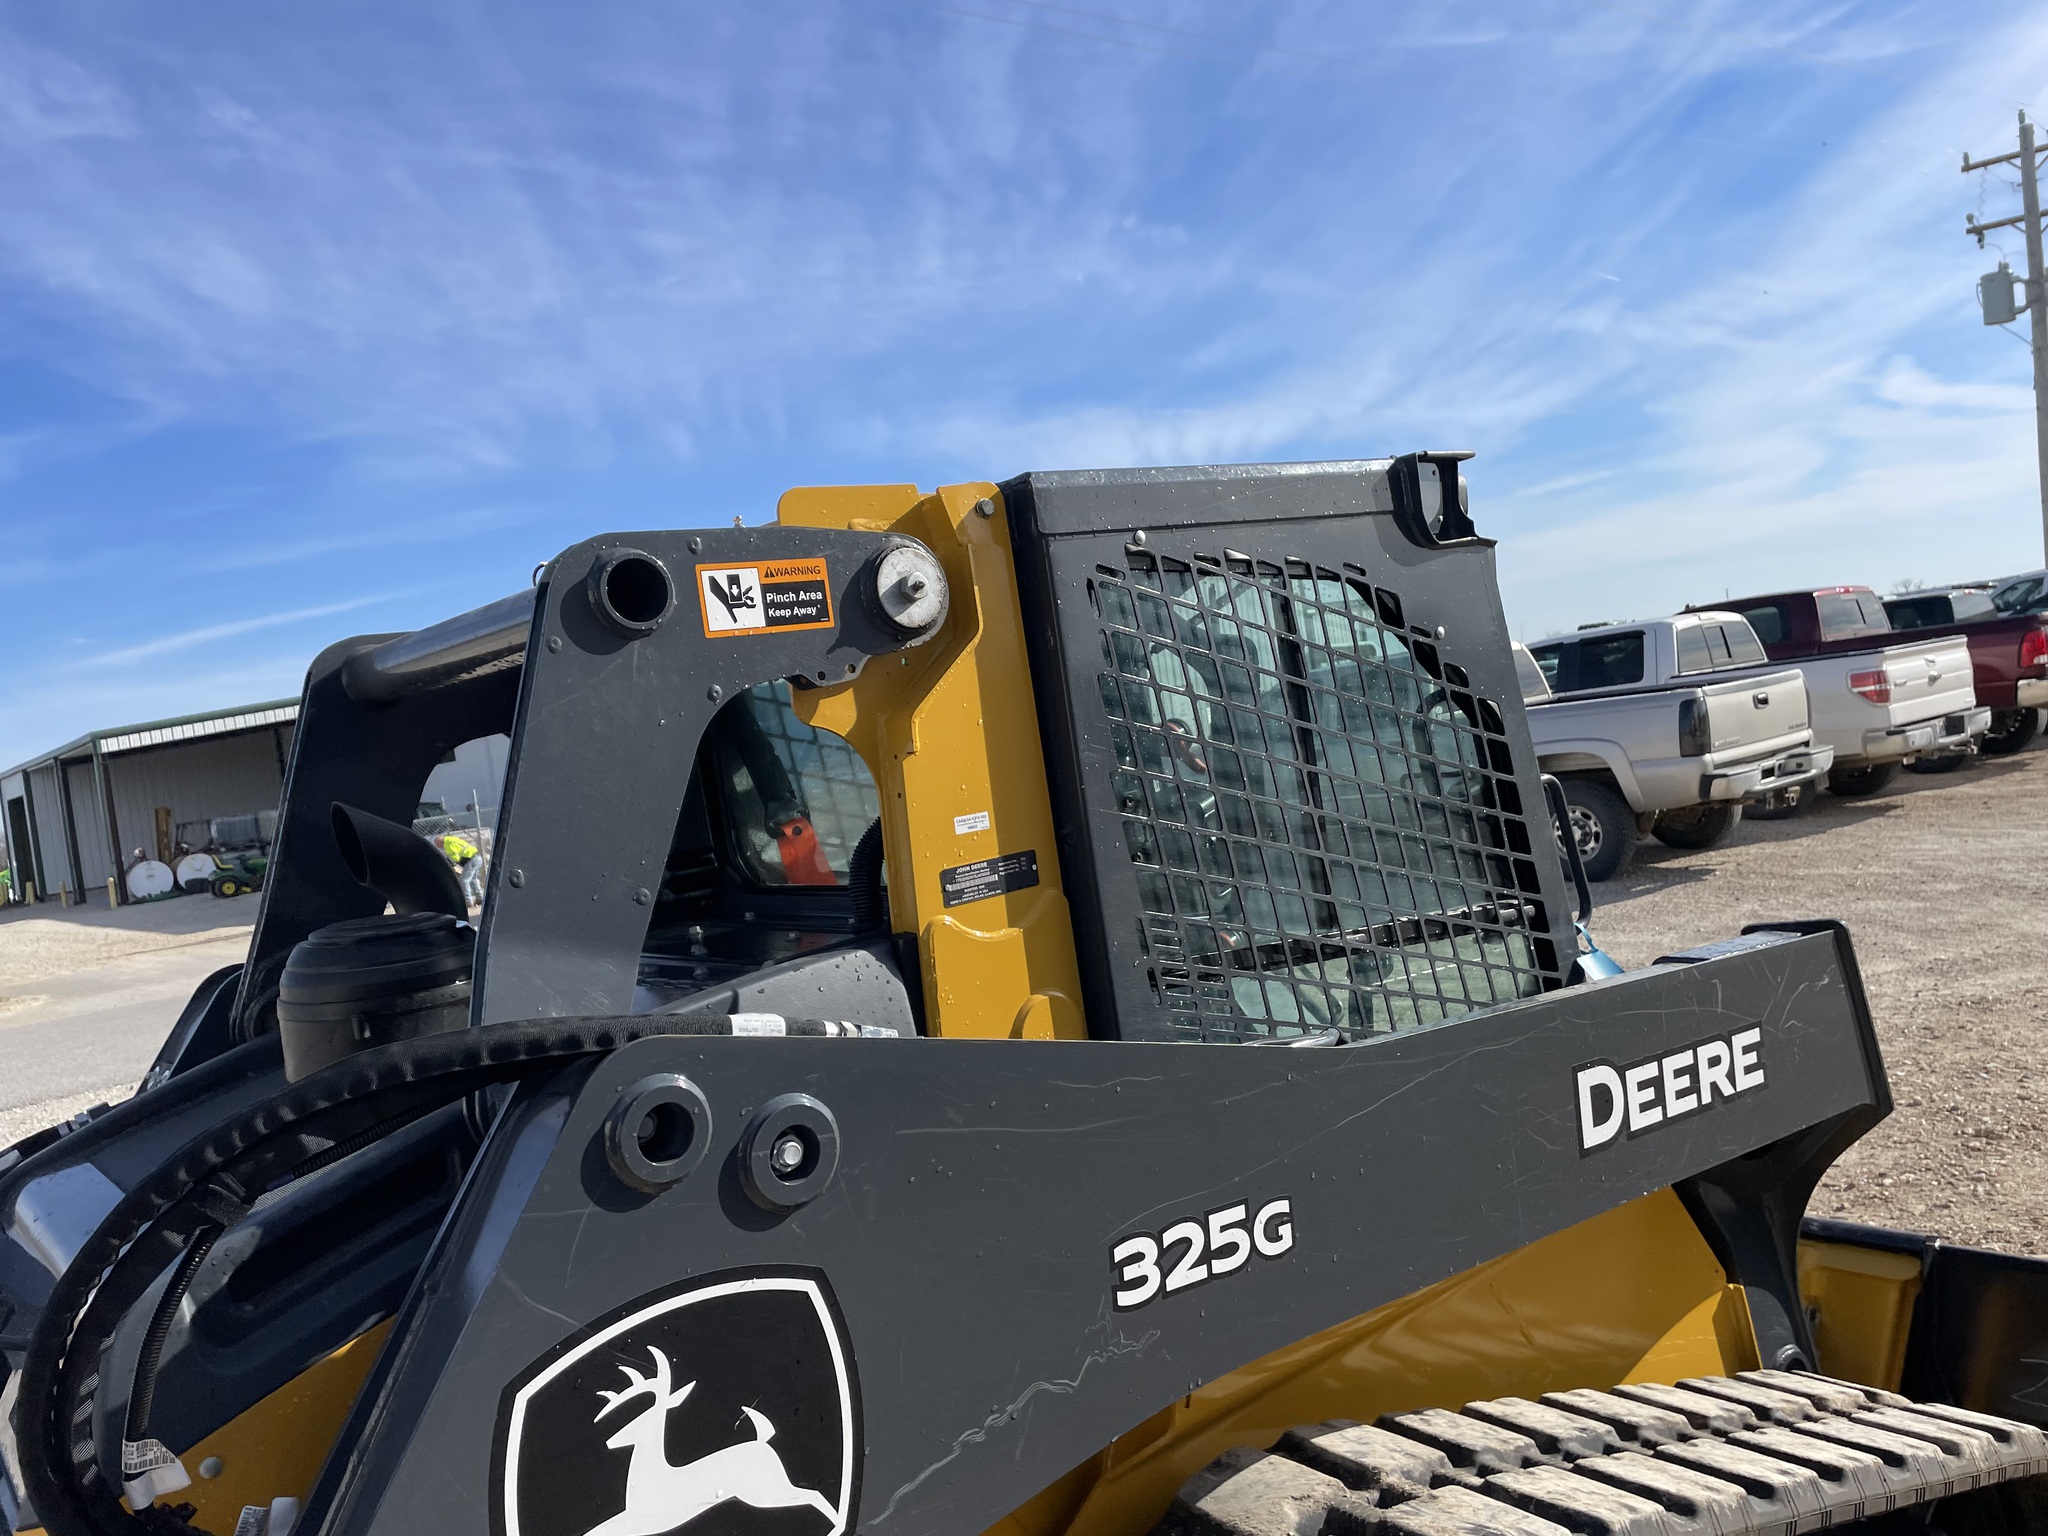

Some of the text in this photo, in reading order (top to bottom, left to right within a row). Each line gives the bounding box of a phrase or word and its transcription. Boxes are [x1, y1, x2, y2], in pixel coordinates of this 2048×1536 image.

[774, 565, 821, 577] WARNING
[766, 590, 823, 604] Pinch Area
[768, 606, 817, 618] Keep Away
[956, 865, 971, 874] JOHN
[971, 862, 988, 871] DEERE
[1577, 1027, 1765, 1149] DEERE
[1113, 1199, 1293, 1307] 325G
